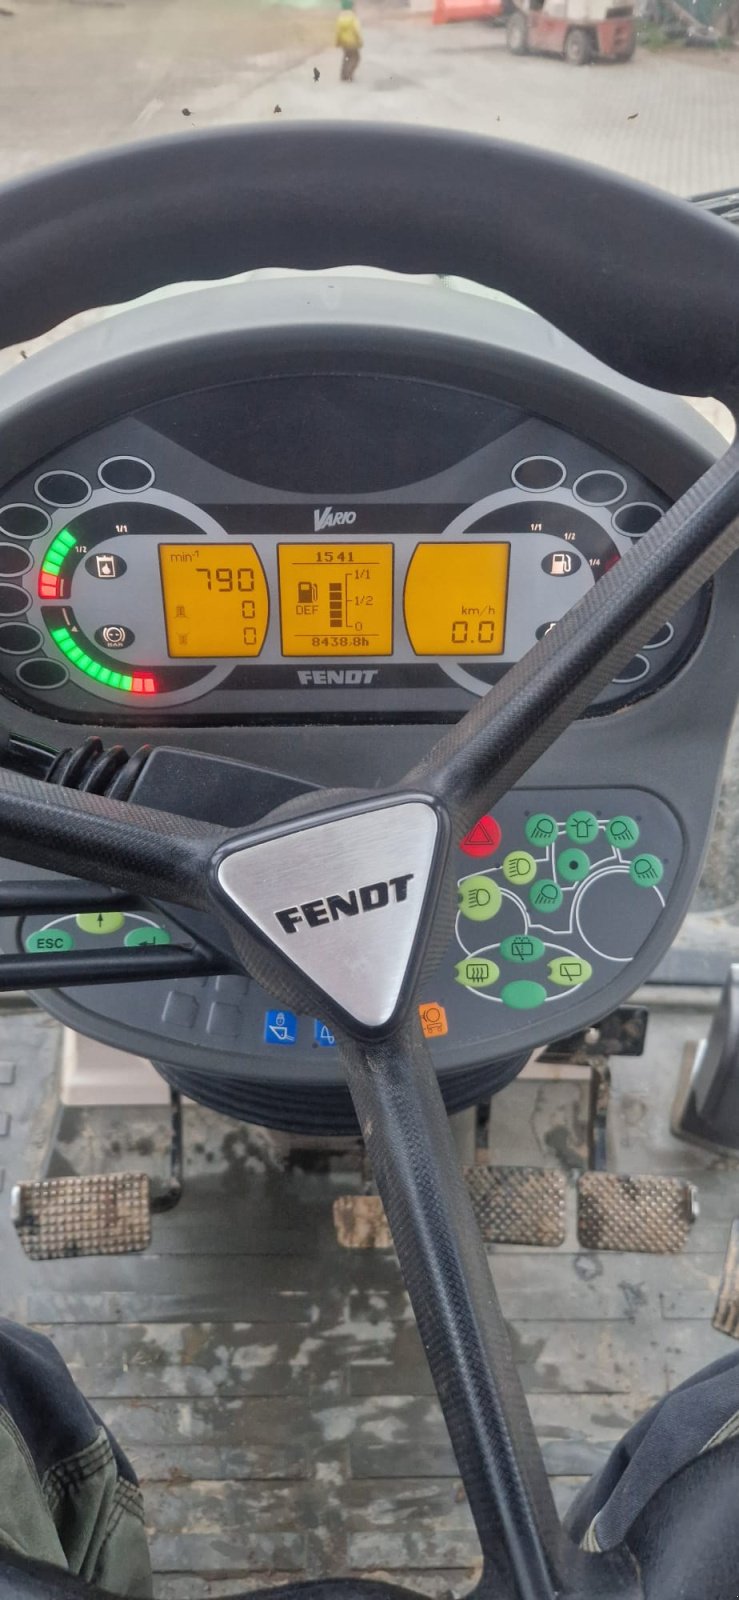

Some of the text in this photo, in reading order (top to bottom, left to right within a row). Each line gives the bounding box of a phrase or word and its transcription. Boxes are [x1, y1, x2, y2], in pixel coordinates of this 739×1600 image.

[314, 506, 357, 532] VARIO
[115, 524, 128, 533] 1/1
[530, 523, 542, 531] 1/1
[564, 532, 576, 540] 1/2
[75, 545, 87, 553] 1/2
[589, 558, 600, 566] 1/4
[354, 569, 371, 579] 1/1
[196, 568, 254, 592] 790
[354, 595, 374, 606] 1/2
[242, 600, 255, 619] 0
[295, 605, 319, 615] DEF
[461, 604, 496, 616] km/h
[243, 627, 256, 645] 0
[451, 620, 495, 643] 0.0
[297, 669, 379, 685] FENDT
[275, 873, 414, 934] FENDT
[36, 938, 64, 949] ESC
